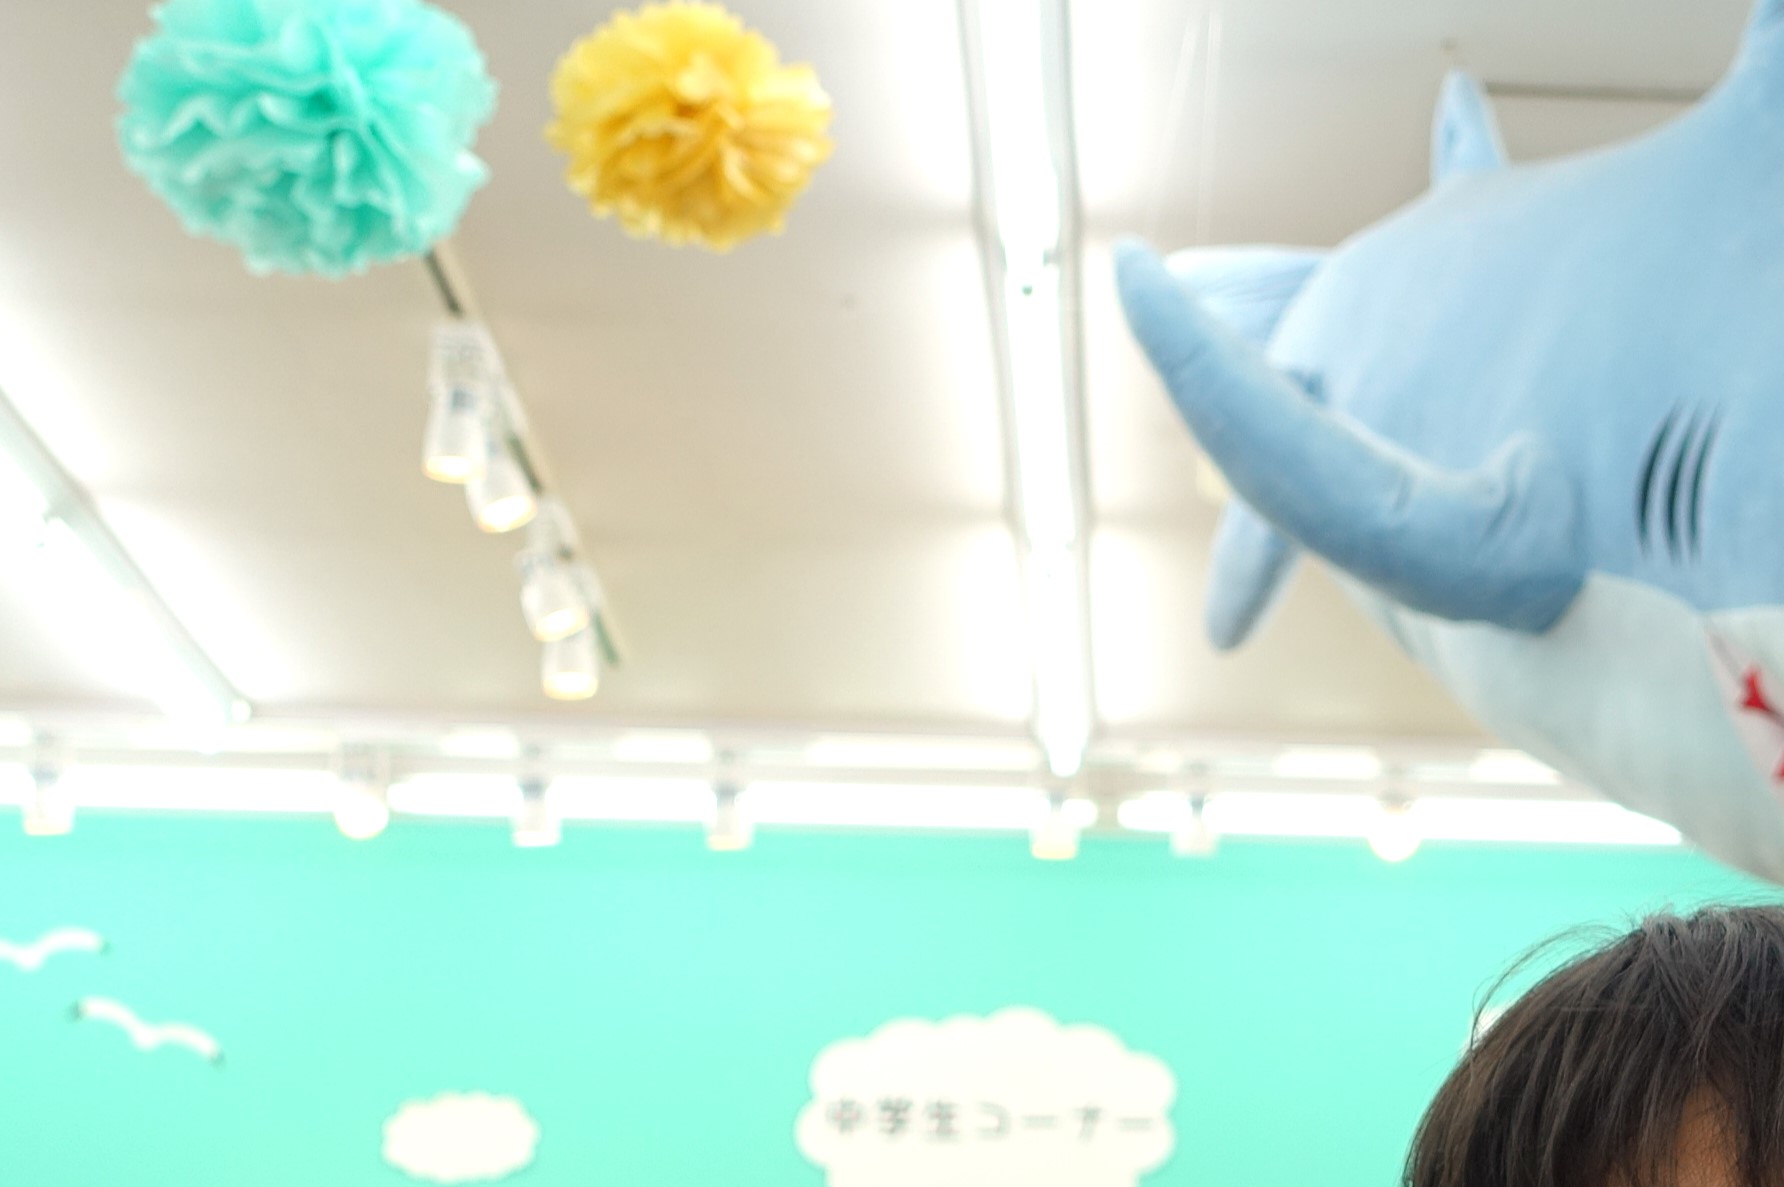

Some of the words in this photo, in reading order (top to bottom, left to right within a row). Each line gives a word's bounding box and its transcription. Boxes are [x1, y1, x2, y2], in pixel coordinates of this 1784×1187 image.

[825, 1097, 1154, 1143] 中学生コーナー
